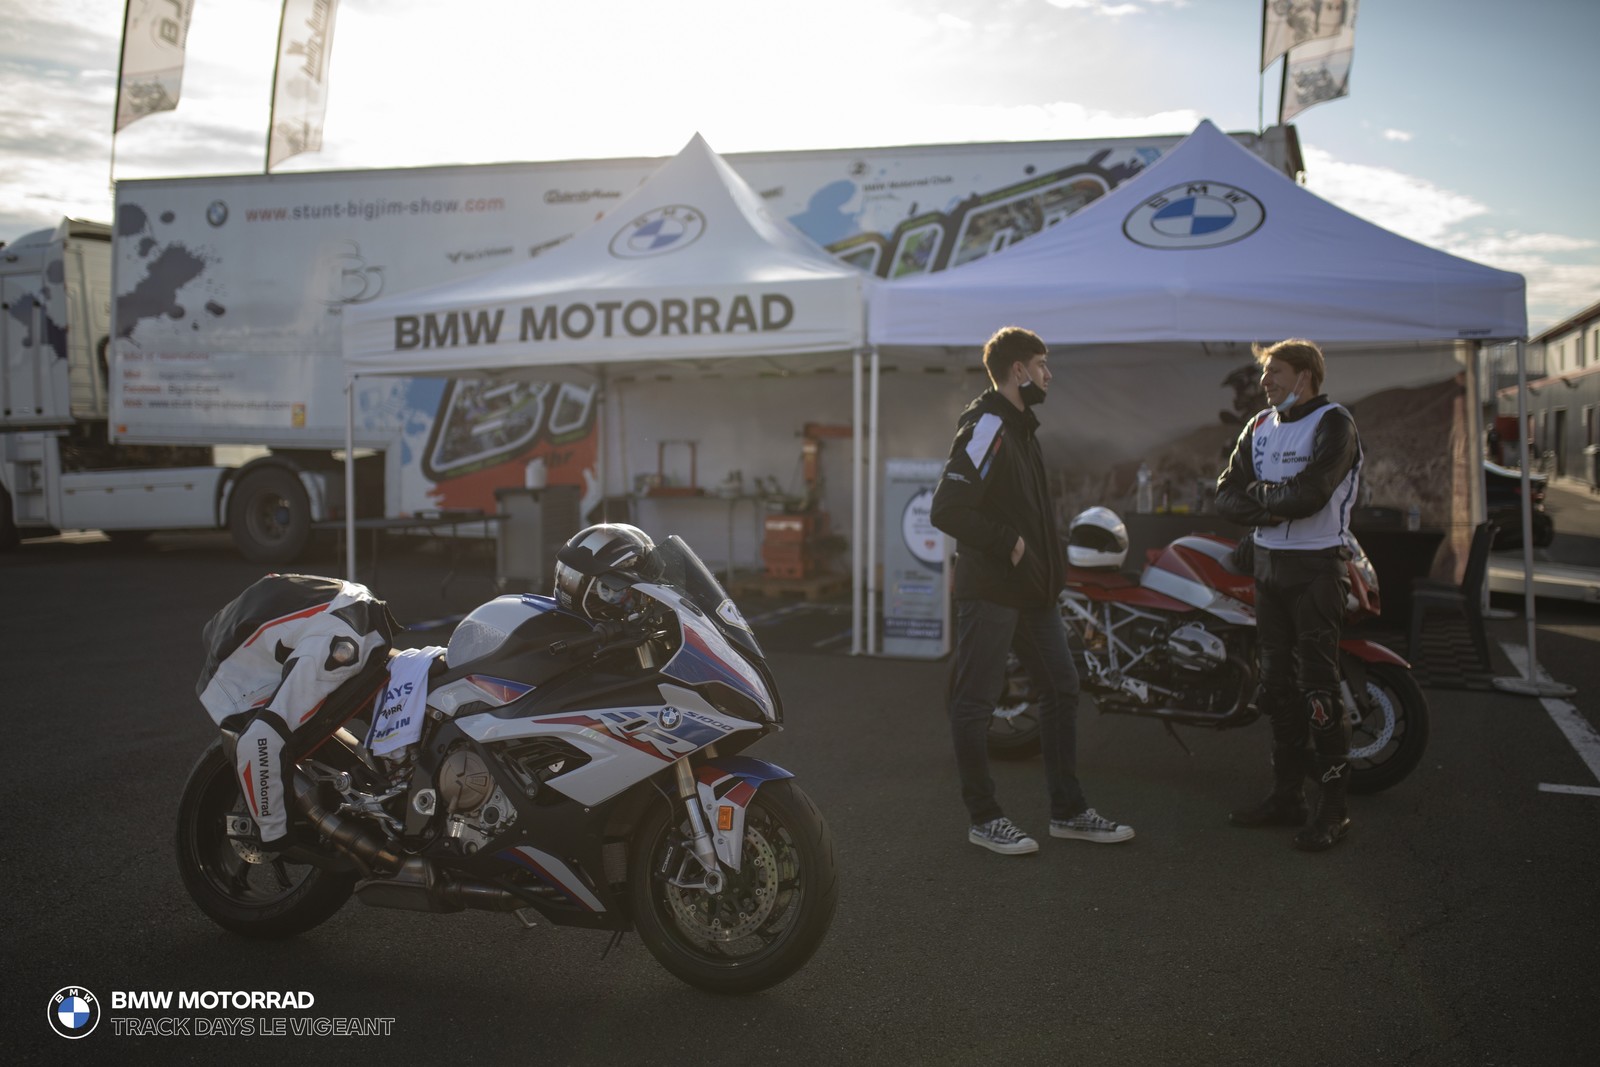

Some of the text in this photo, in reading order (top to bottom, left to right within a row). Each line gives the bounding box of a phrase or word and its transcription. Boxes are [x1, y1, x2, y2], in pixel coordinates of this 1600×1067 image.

[245, 197, 504, 221] www.stunt-bigjim-show.com
[394, 294, 795, 352] BMW MOTORRAD
[385, 682, 414, 703] AYS
[257, 738, 271, 817] BMW Motorrad
